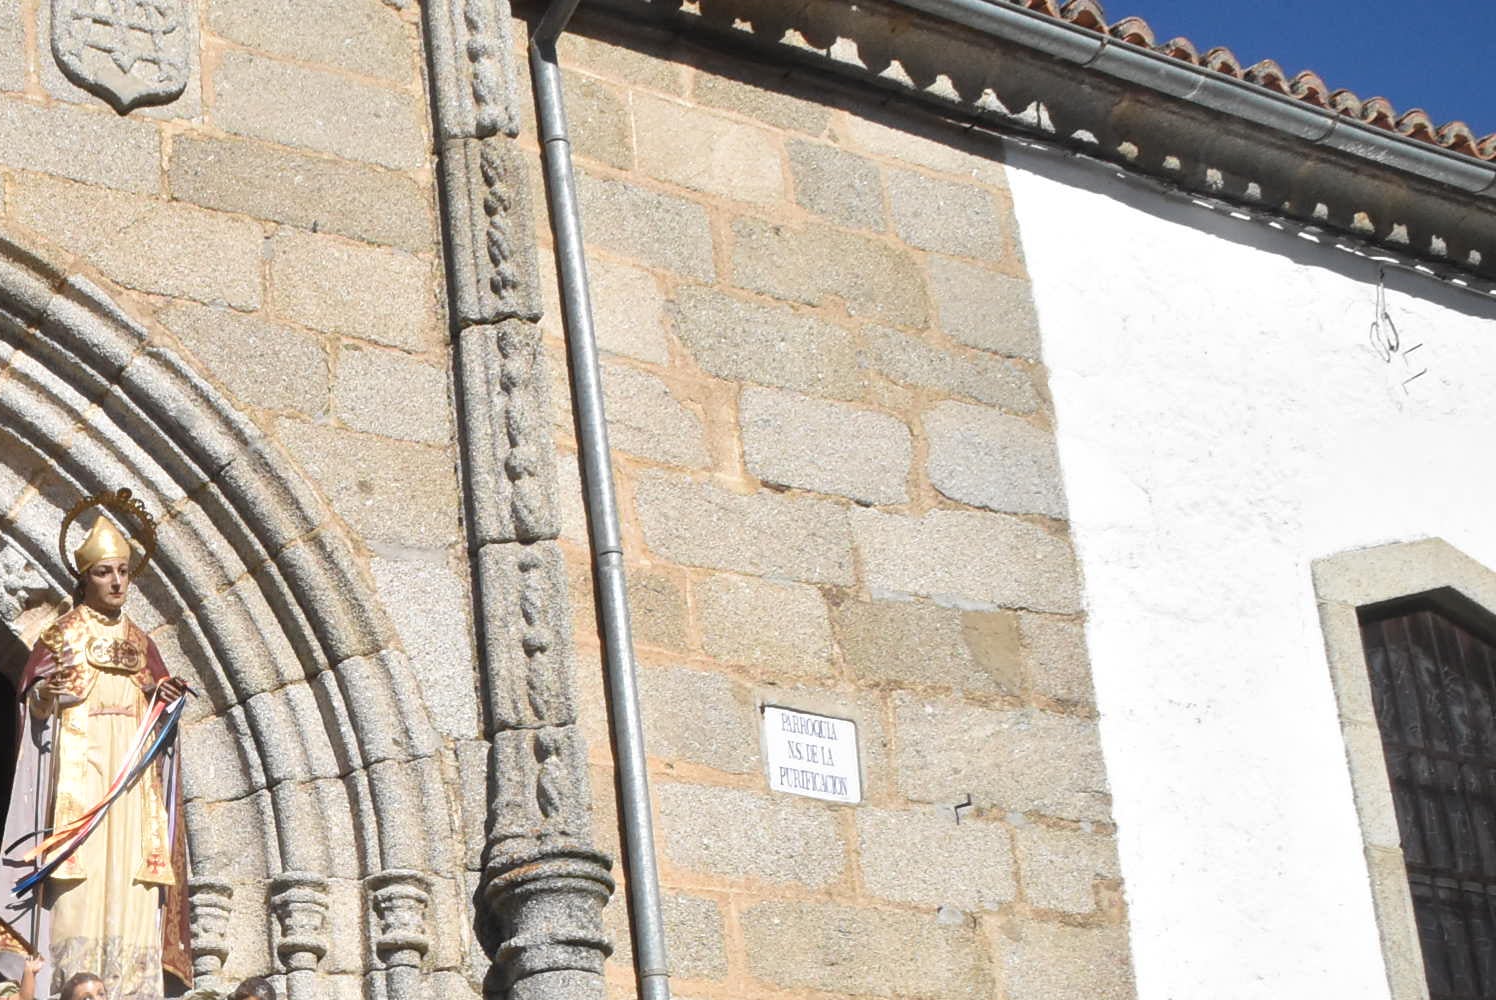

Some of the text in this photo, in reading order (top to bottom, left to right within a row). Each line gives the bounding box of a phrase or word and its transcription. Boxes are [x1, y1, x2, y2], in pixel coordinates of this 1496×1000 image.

[781, 713, 837, 740] PARROQUIA
[806, 744, 819, 763] DE
[821, 746, 834, 766] LA
